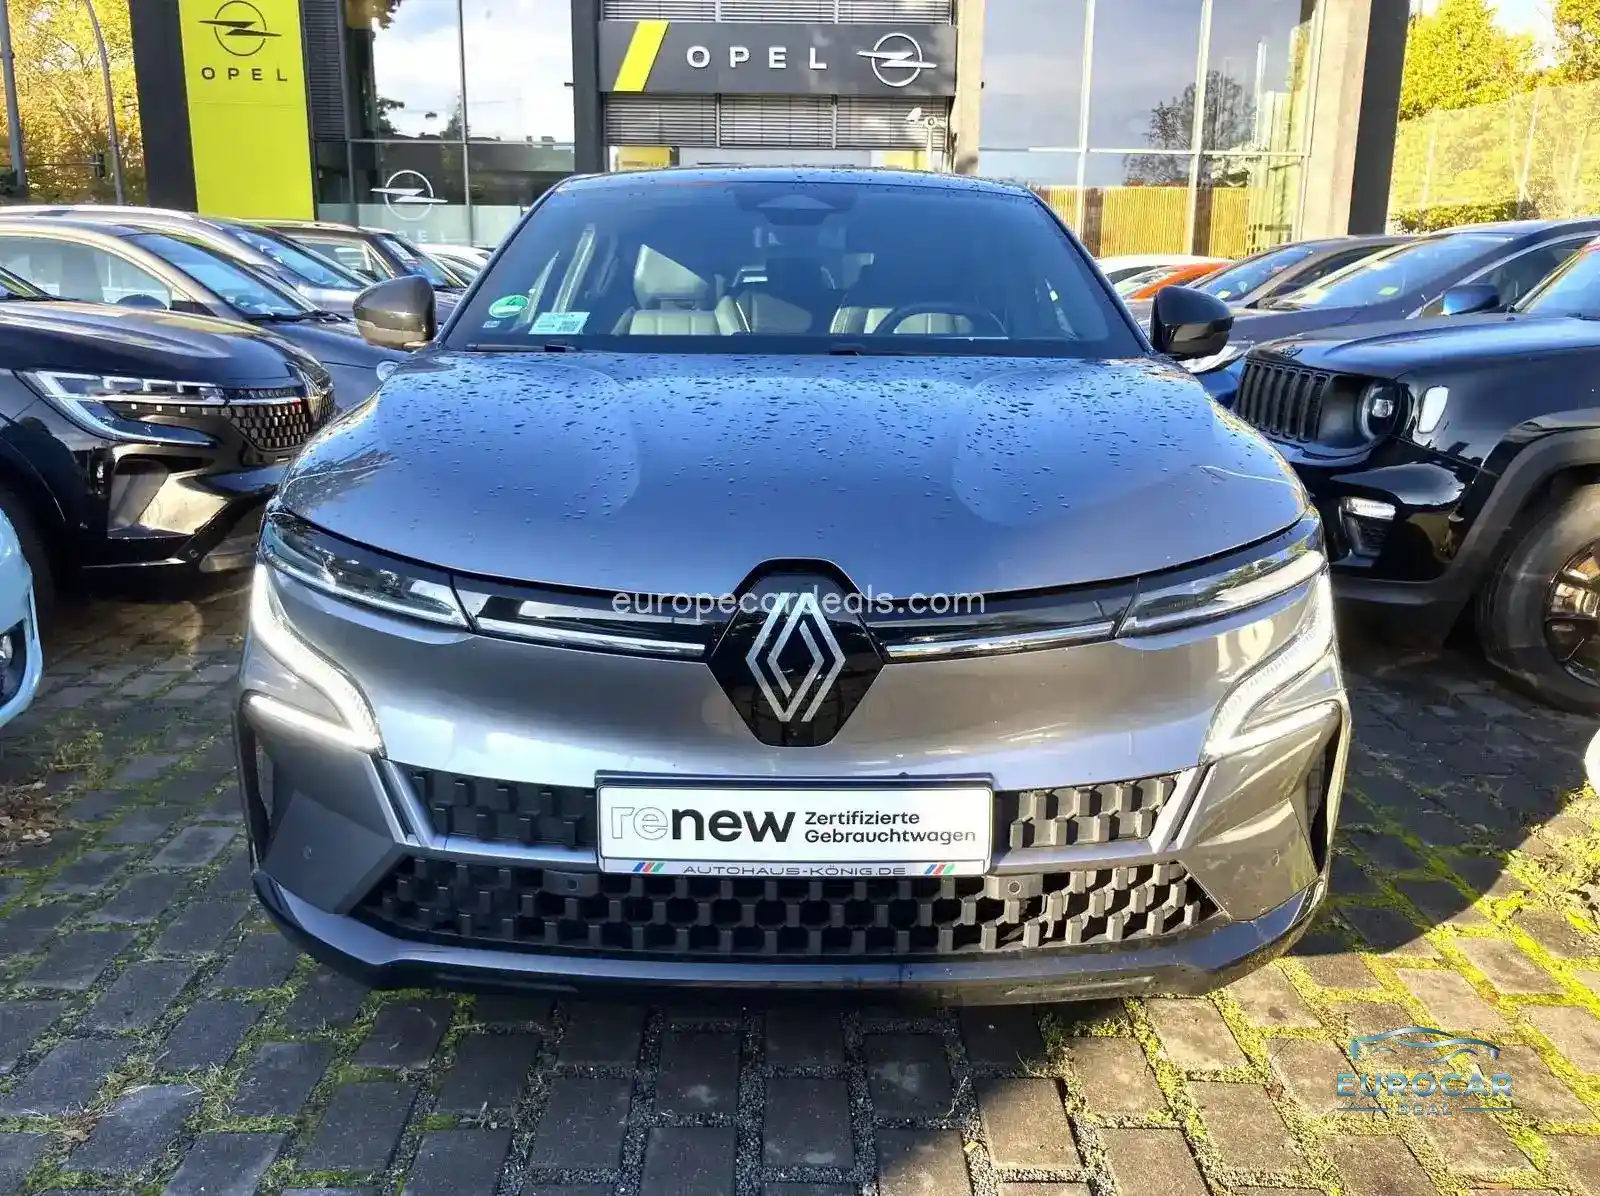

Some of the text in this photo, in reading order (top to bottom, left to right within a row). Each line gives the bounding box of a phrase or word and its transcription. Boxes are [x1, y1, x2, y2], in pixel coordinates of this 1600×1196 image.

[686, 45, 828, 70] OPEL
[201, 67, 288, 81] OPEL
[611, 805, 796, 843] renew
[804, 810, 920, 826] Zertifizierte
[804, 828, 976, 846] Gebrauchtwagen
[683, 864, 907, 876] AUTOHAUS-KÖNIG.DE
